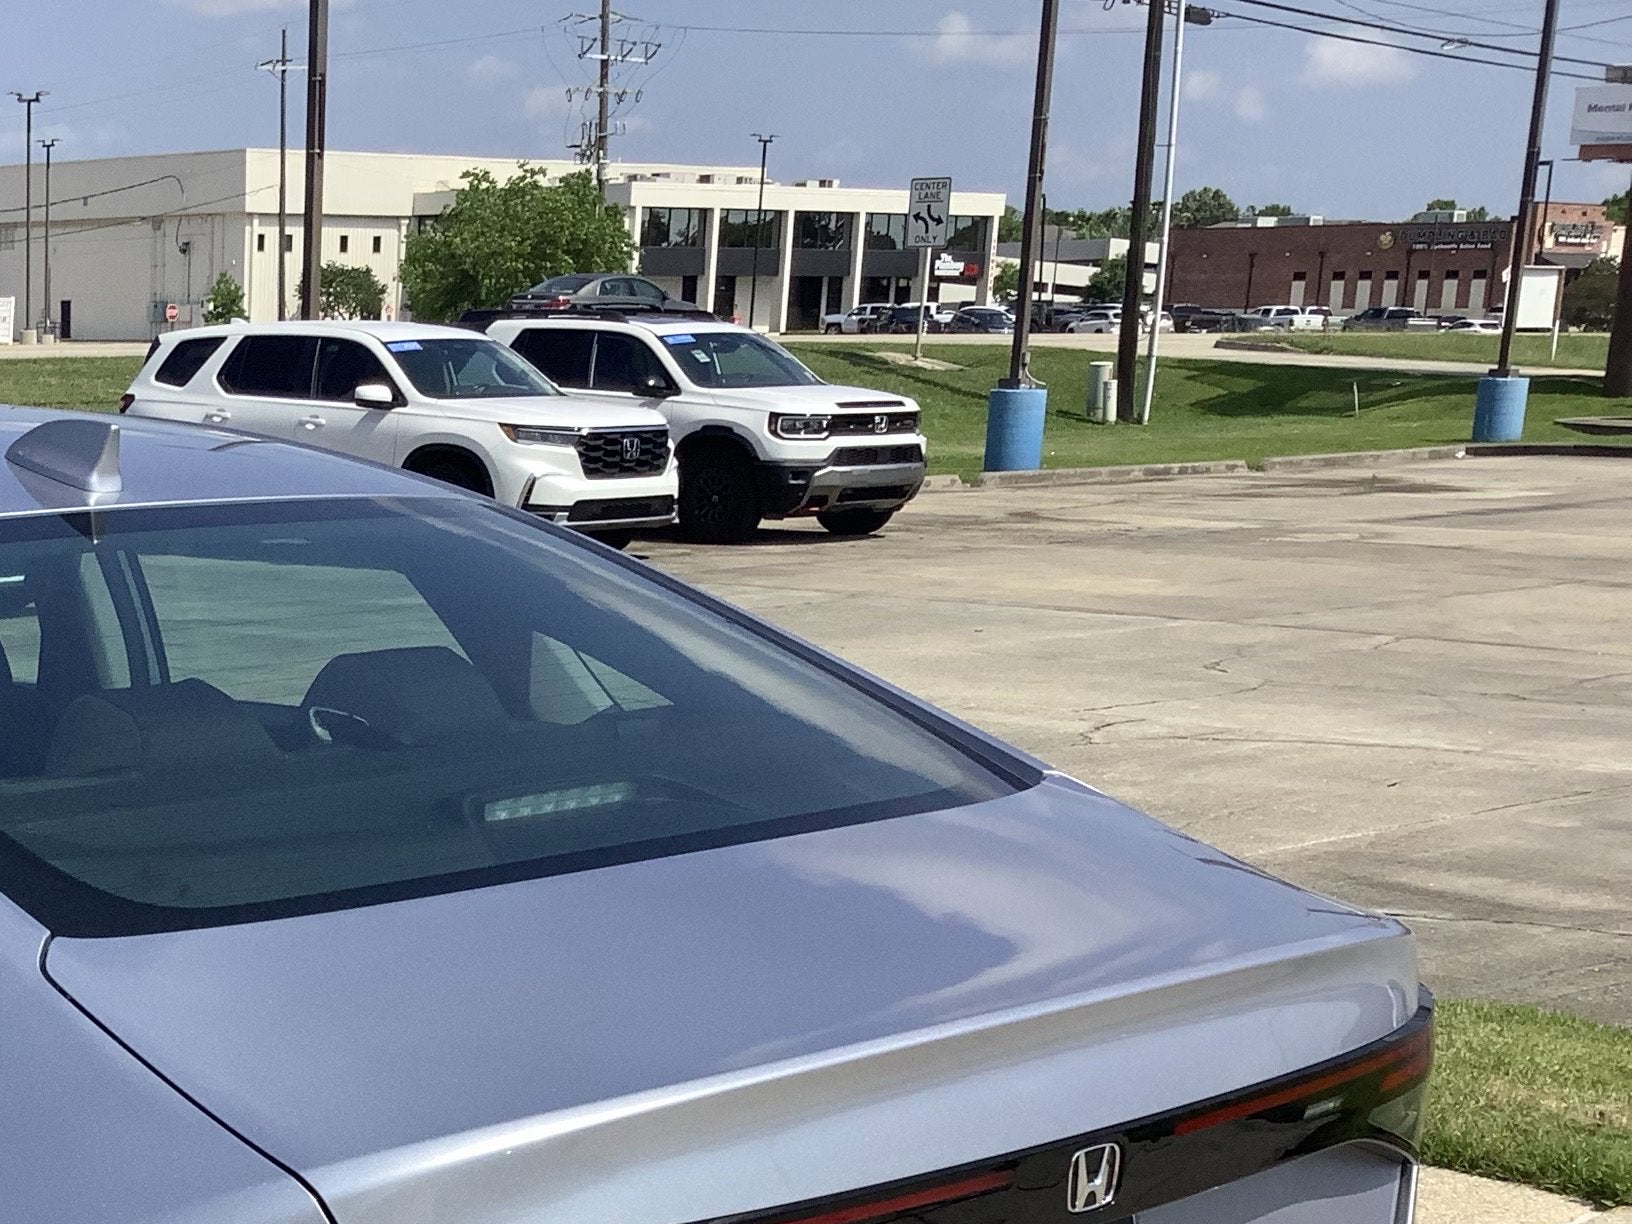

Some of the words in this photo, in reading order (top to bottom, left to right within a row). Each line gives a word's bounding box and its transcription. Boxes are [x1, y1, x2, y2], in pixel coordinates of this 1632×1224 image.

[914, 181, 948, 191] CENTER
[918, 191, 942, 200] LANE
[914, 234, 938, 244] ONLY
[1399, 229, 1467, 241] DUMPLING
[1481, 229, 1507, 241] BAO
